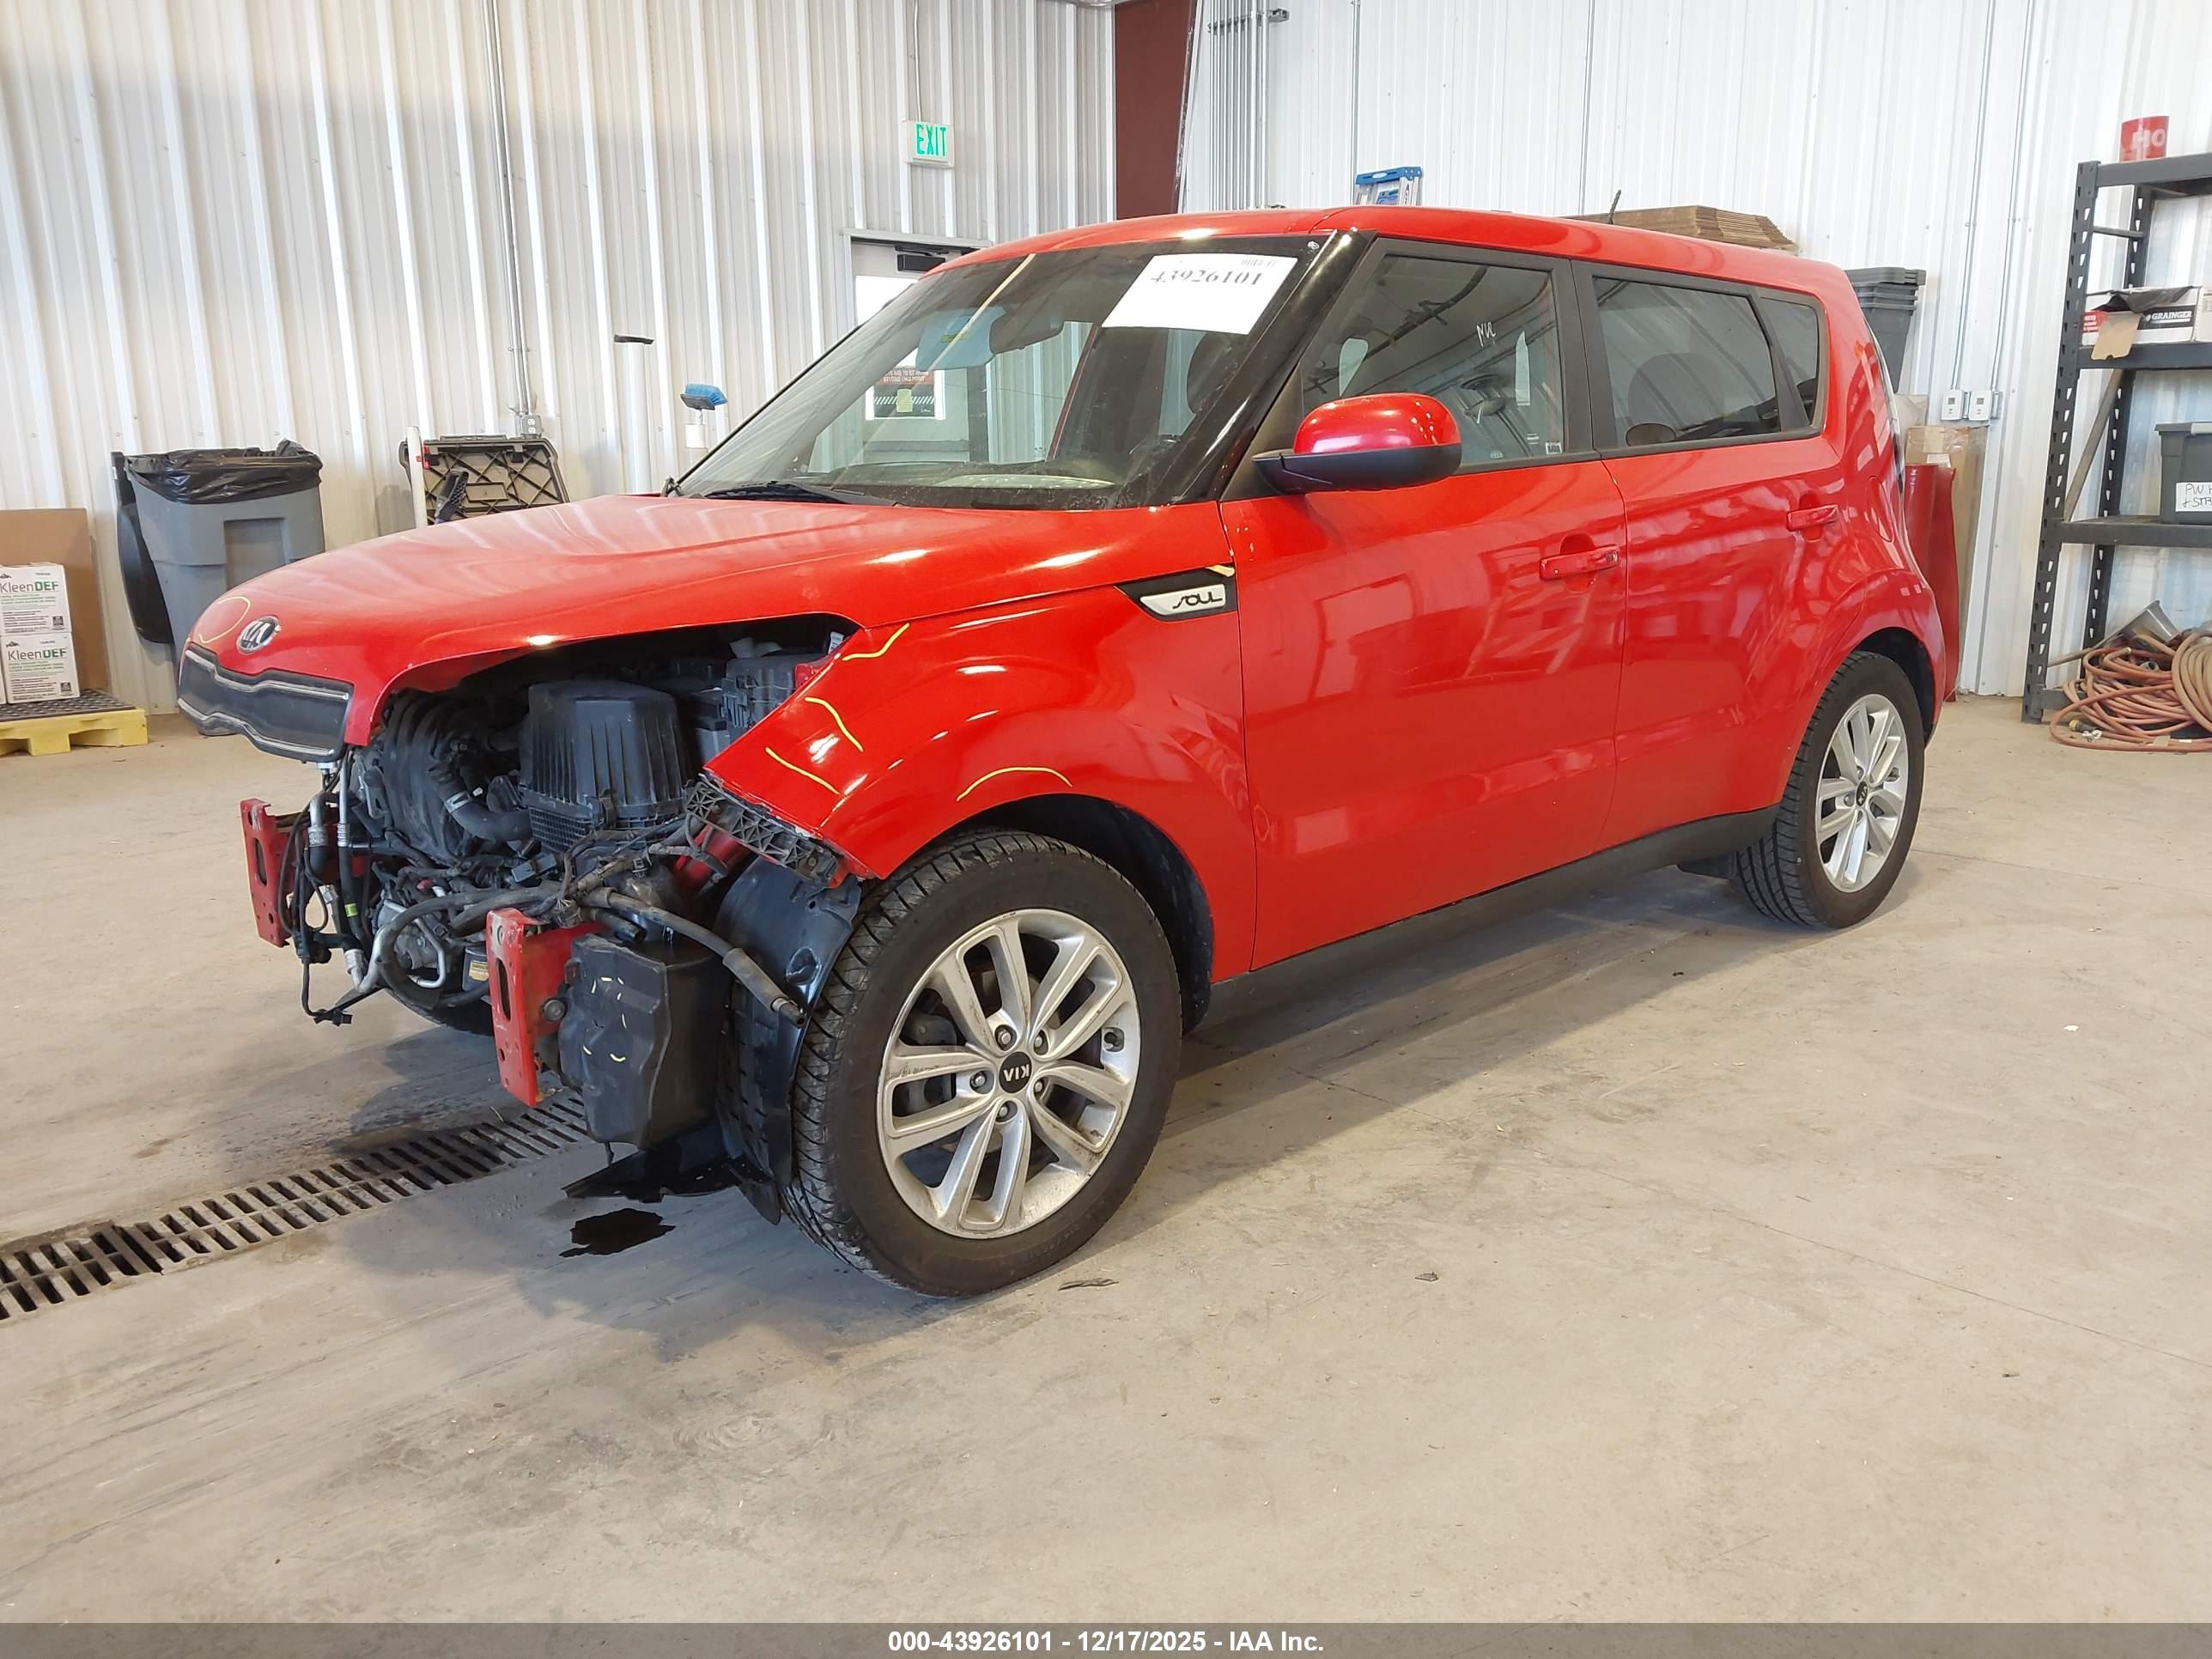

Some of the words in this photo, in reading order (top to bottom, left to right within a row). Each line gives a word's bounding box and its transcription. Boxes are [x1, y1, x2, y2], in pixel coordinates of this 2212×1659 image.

[916, 124, 946, 156] EXIT
[1150, 270, 1263, 286] 43926101
[2151, 311, 2192, 319] GRAINGER
[0, 581, 59, 593] KleenDEF
[1172, 592, 1223, 609] SOUL
[8, 648, 67, 660] KleenDEF
[1003, 1064, 1030, 1082] KIA
